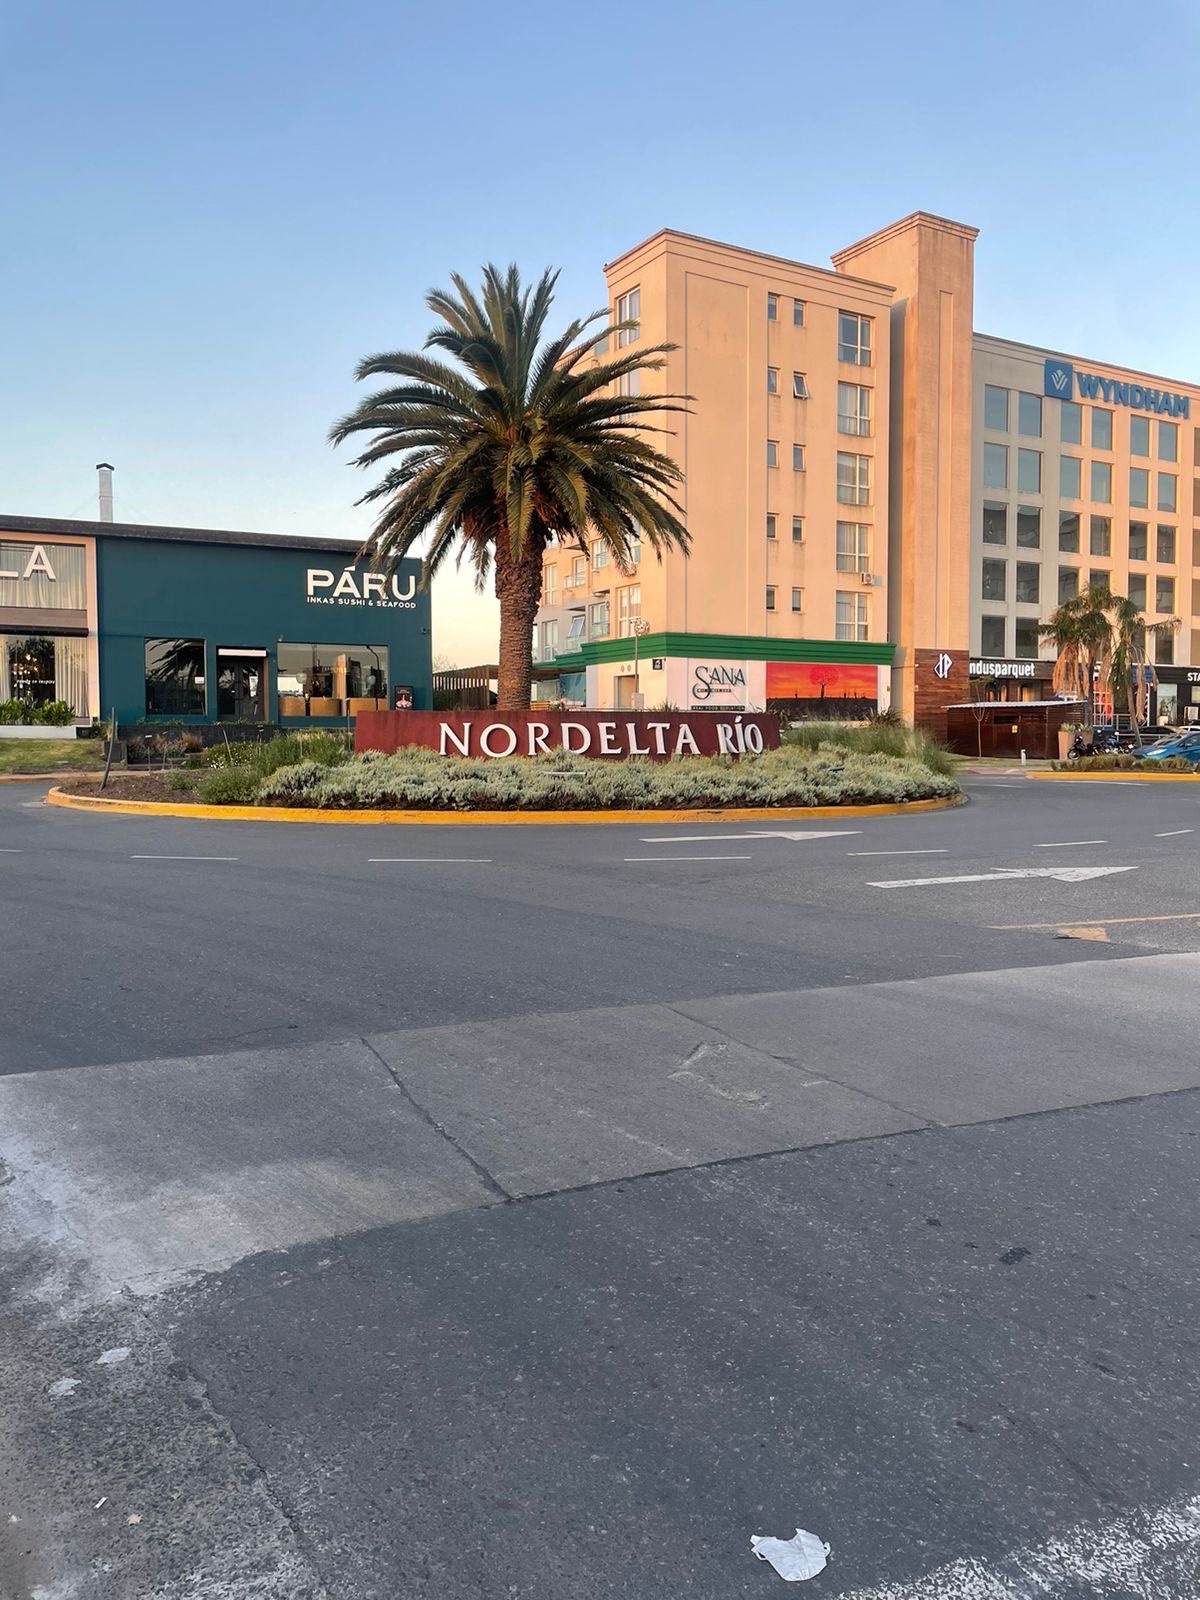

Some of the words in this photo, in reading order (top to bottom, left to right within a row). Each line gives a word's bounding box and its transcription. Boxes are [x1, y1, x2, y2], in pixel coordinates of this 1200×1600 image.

[1076, 372, 1190, 419] WYNDHAM
[307, 565, 416, 601] PÁRU
[307, 596, 335, 605] INKAS
[338, 597, 366, 606] SUSHI
[376, 600, 417, 609] SEAFOOD
[692, 664, 746, 700] SANA
[439, 722, 701, 758] NORDELTA
[716, 715, 764, 754] RÍO
